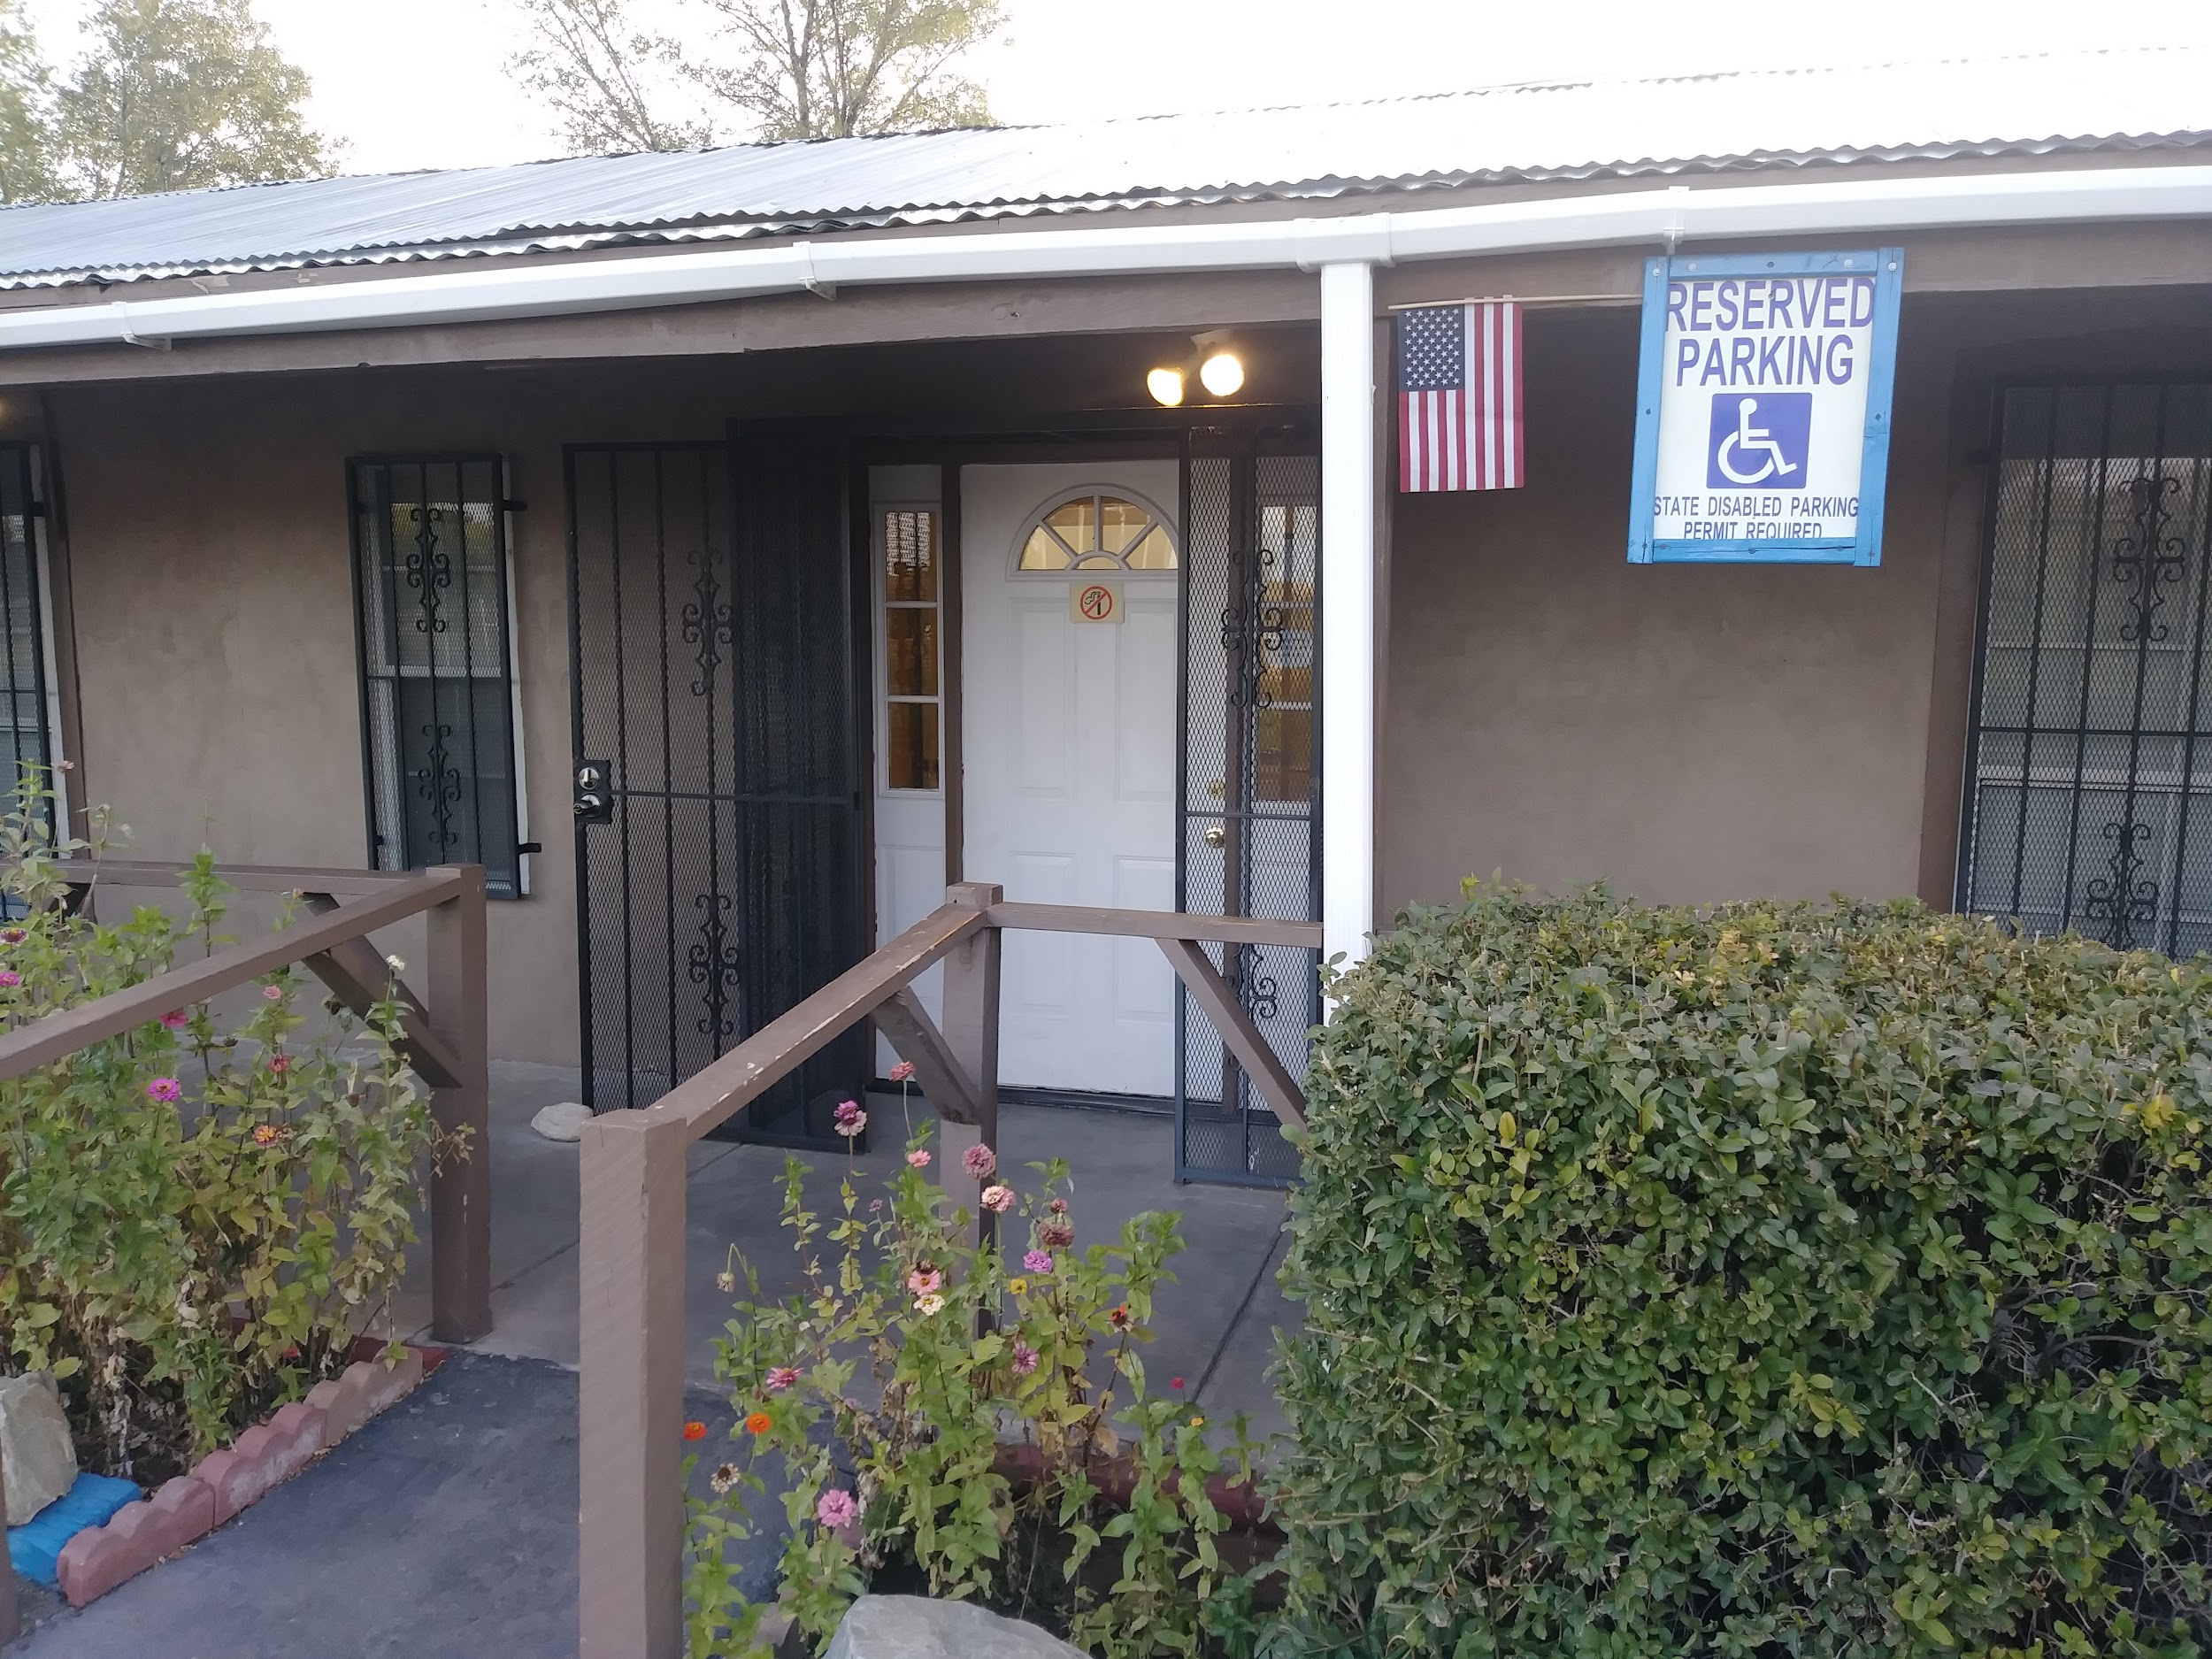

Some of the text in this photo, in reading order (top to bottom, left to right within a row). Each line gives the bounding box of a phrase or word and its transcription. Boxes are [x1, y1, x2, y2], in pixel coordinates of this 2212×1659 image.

[1666, 278, 1875, 333] RESERVED
[1677, 334, 1854, 387] PARKING
[1654, 496, 1858, 518] STATE DISABLED PARKING
[1684, 521, 1823, 540] PERMIT REQUIRED
